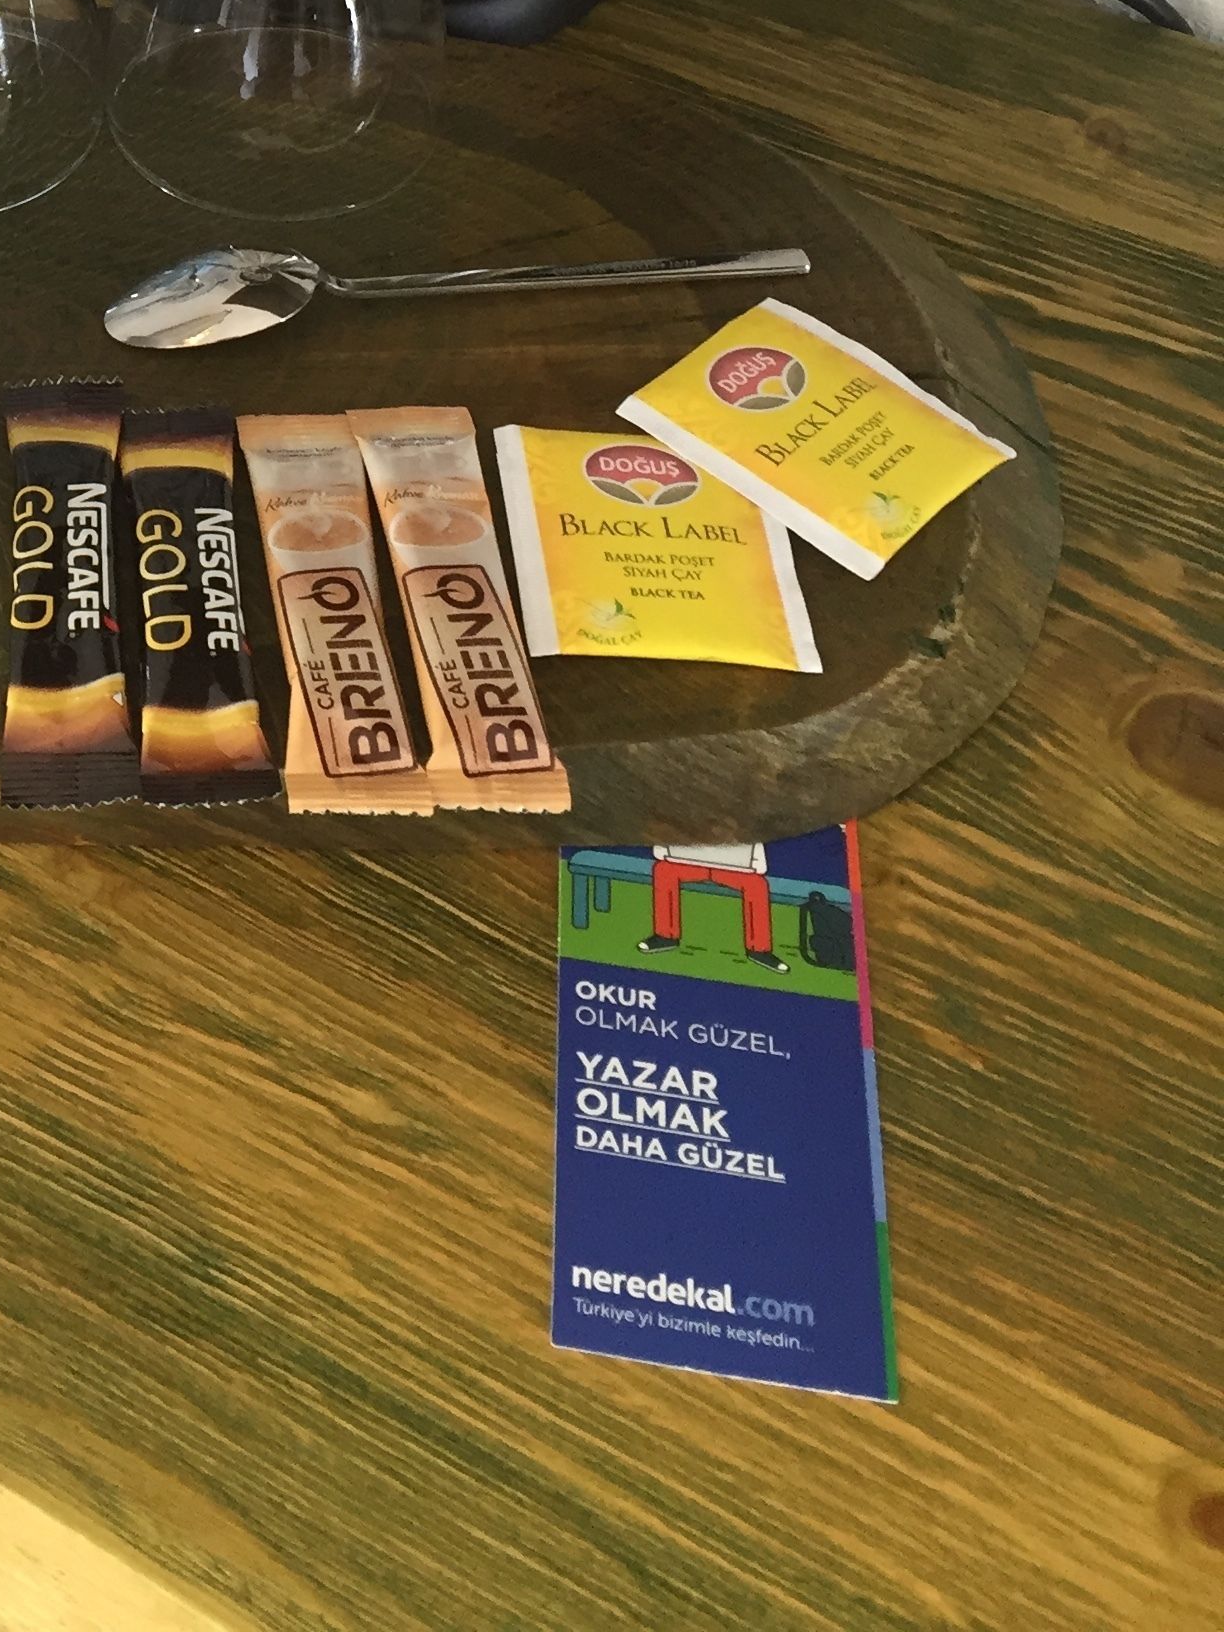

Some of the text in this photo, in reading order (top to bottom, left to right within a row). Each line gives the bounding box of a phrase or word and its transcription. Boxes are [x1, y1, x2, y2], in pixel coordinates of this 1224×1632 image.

[721, 352, 776, 394] DOĞUŞ
[599, 455, 680, 478] DOĞUŞ
[10, 485, 54, 630] GOLD
[136, 509, 191, 651] GOLD
[299, 575, 402, 765] BRENO
[424, 573, 537, 764] BRENO
[575, 980, 657, 1011] OKUR
[575, 1006, 791, 1060] OLMAK GÜZEL,
[576, 1051, 719, 1101] YAZAR
[576, 1088, 729, 1138] OLMAK
[575, 1126, 786, 1180] DAHA GÜZEL
[572, 1265, 815, 1328] neredekal.com
[658, 1313, 721, 1337] bizimle
